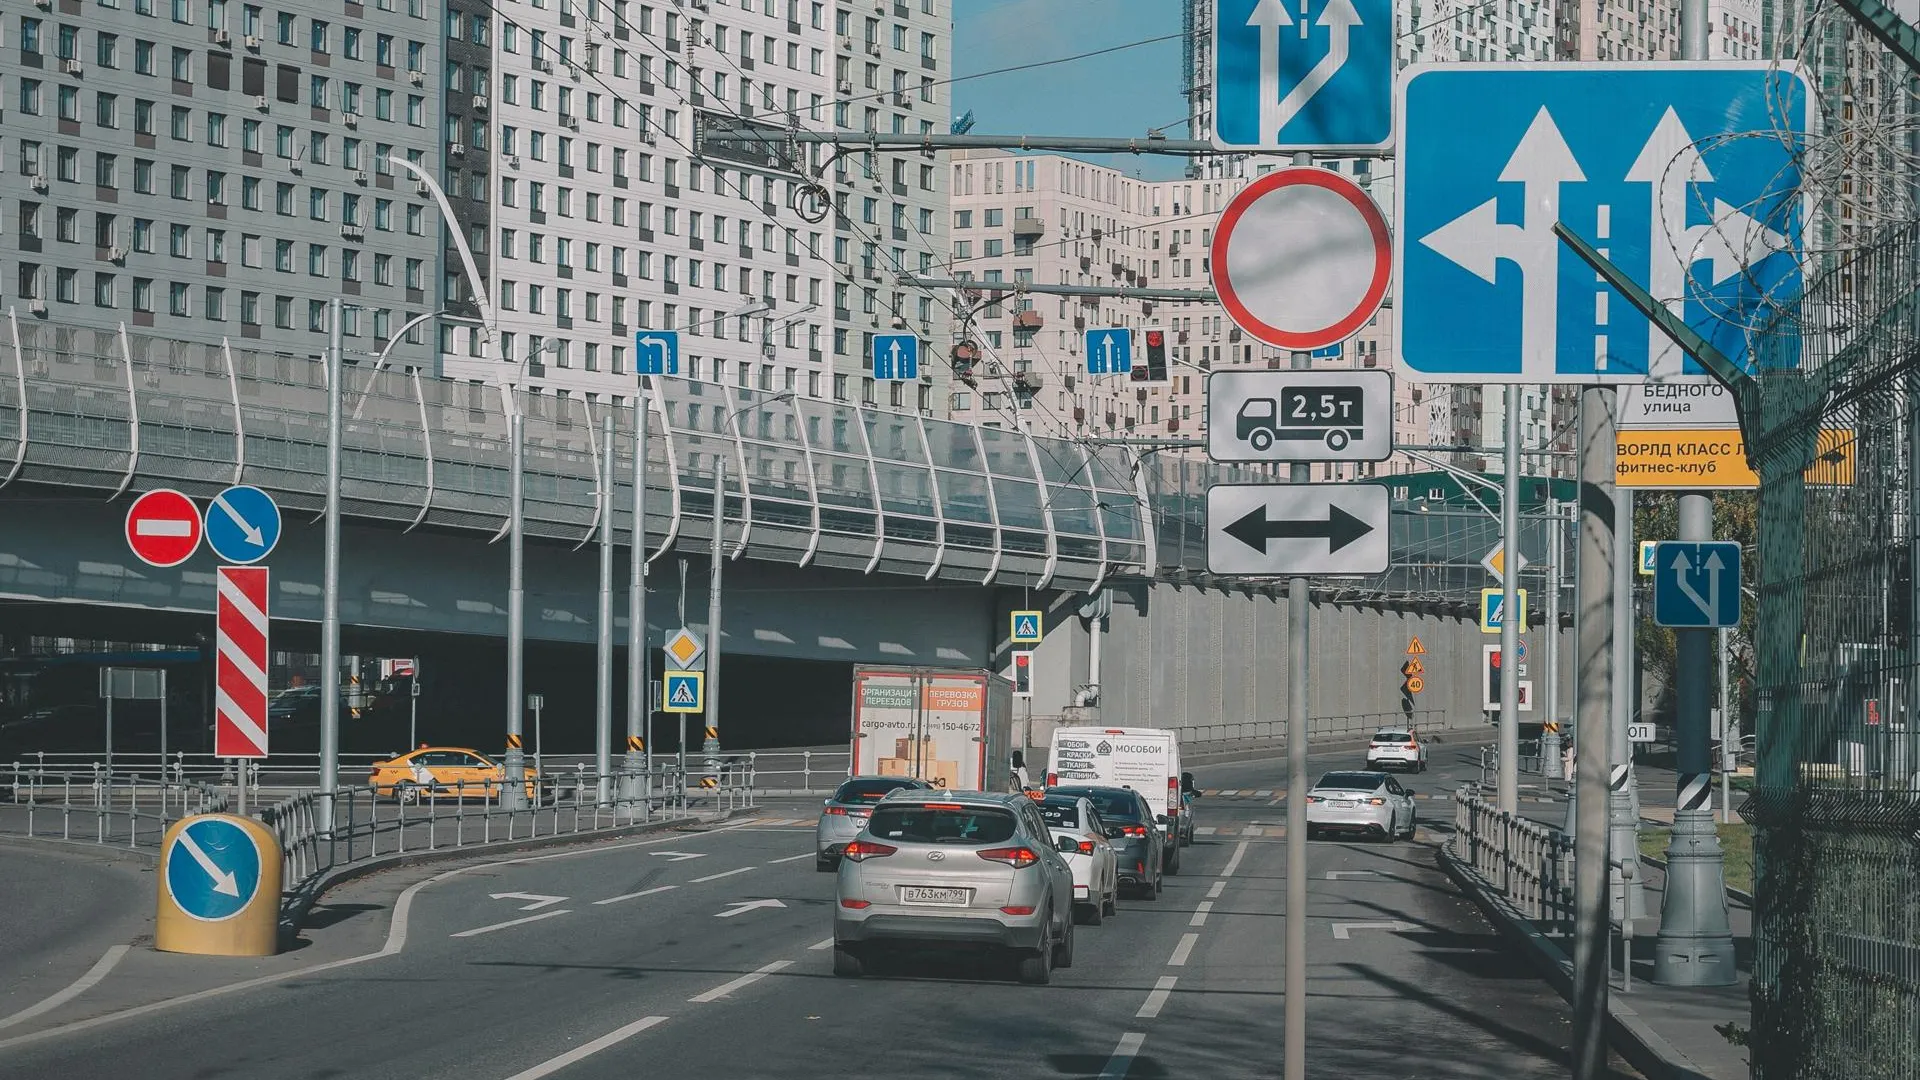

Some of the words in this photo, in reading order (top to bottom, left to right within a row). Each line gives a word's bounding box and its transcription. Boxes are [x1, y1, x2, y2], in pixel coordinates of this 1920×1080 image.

[1644, 384, 1723, 399] БЕДНОГО
[1643, 402, 1691, 416] улица
[1617, 443, 1671, 458] ВОРЛД
[1677, 443, 1730, 456] КЛАСС
[1617, 460, 1716, 476] фитнес-клуб
[1410, 680, 1421, 688] 40
[929, 690, 977, 699] ПЕРЕВОЗКА
[865, 697, 911, 707] ПЕРЕЕЗДОВ
[936, 700, 969, 708] ГРУЗОВ
[861, 720, 916, 730] cargo-avto.ru
[942, 722, 980, 732] 150-46-72
[1067, 741, 1085, 749] ОБОИ
[1115, 745, 1162, 754] МОСОБОИ
[1066, 752, 1092, 760] КРАСКИ
[1066, 772, 1097, 780] ЛЕПНИНА
